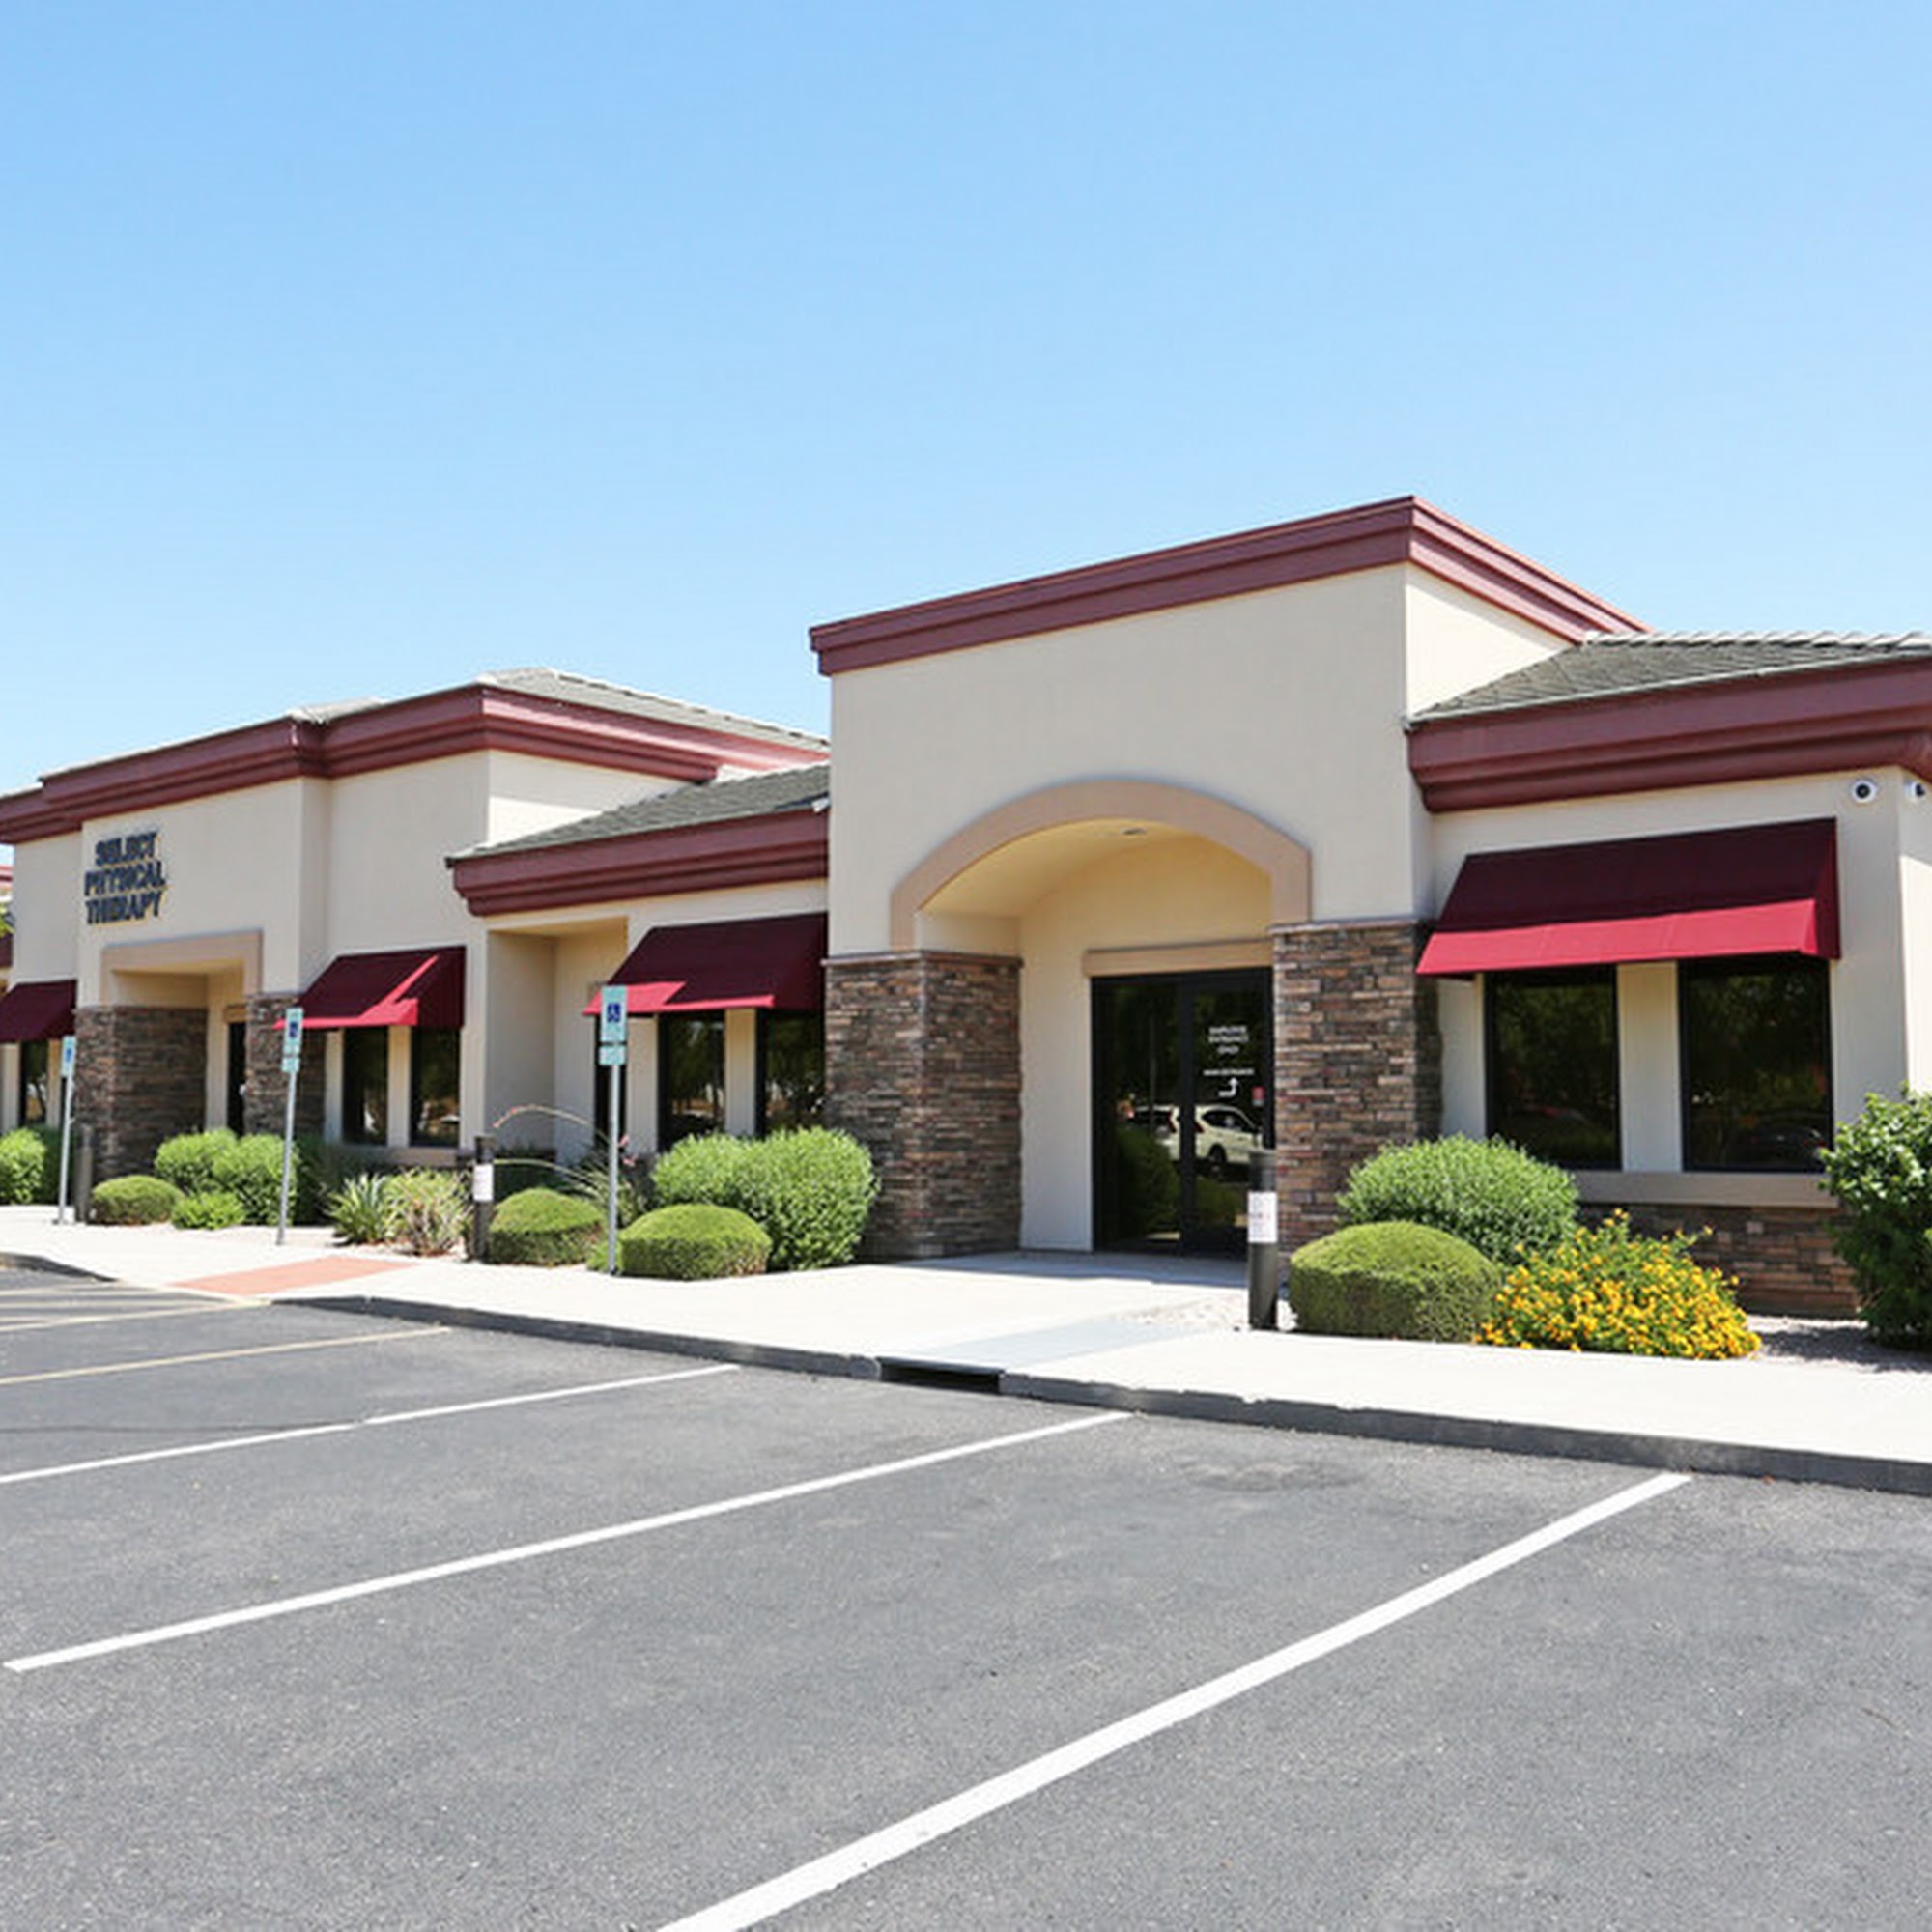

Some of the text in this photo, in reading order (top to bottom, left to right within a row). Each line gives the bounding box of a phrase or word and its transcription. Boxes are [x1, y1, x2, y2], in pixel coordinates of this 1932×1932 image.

[95, 832, 156, 867] SELECT
[84, 860, 166, 896] PHYSICAL
[85, 891, 162, 924] THERAPY
